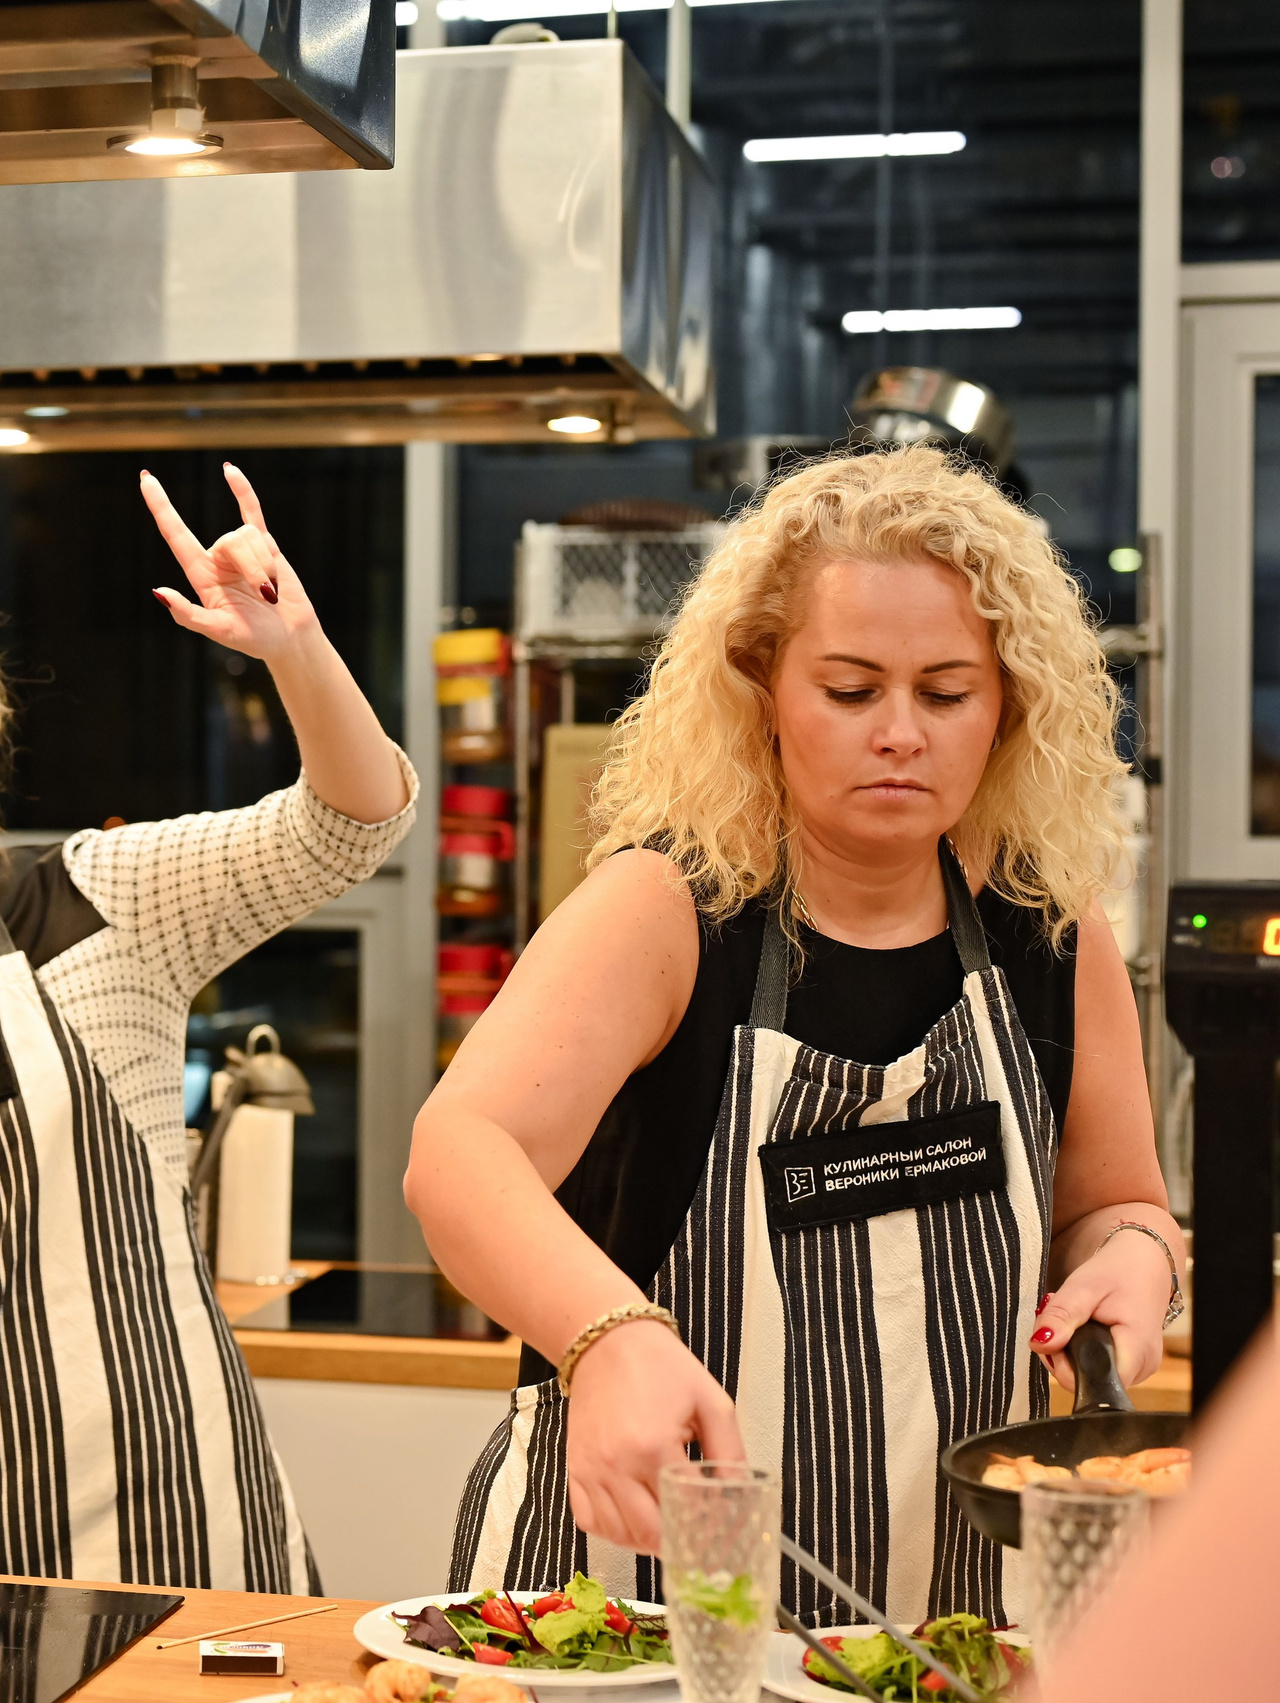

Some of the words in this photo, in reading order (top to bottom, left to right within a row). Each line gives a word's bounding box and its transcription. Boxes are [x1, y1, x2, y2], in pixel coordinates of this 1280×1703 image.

[925, 1136, 972, 1156] САЛОН
[824, 1168, 900, 1191] ВЕРОНИКИ
[904, 1147, 987, 1177] ЕРМАКОВОЙ
